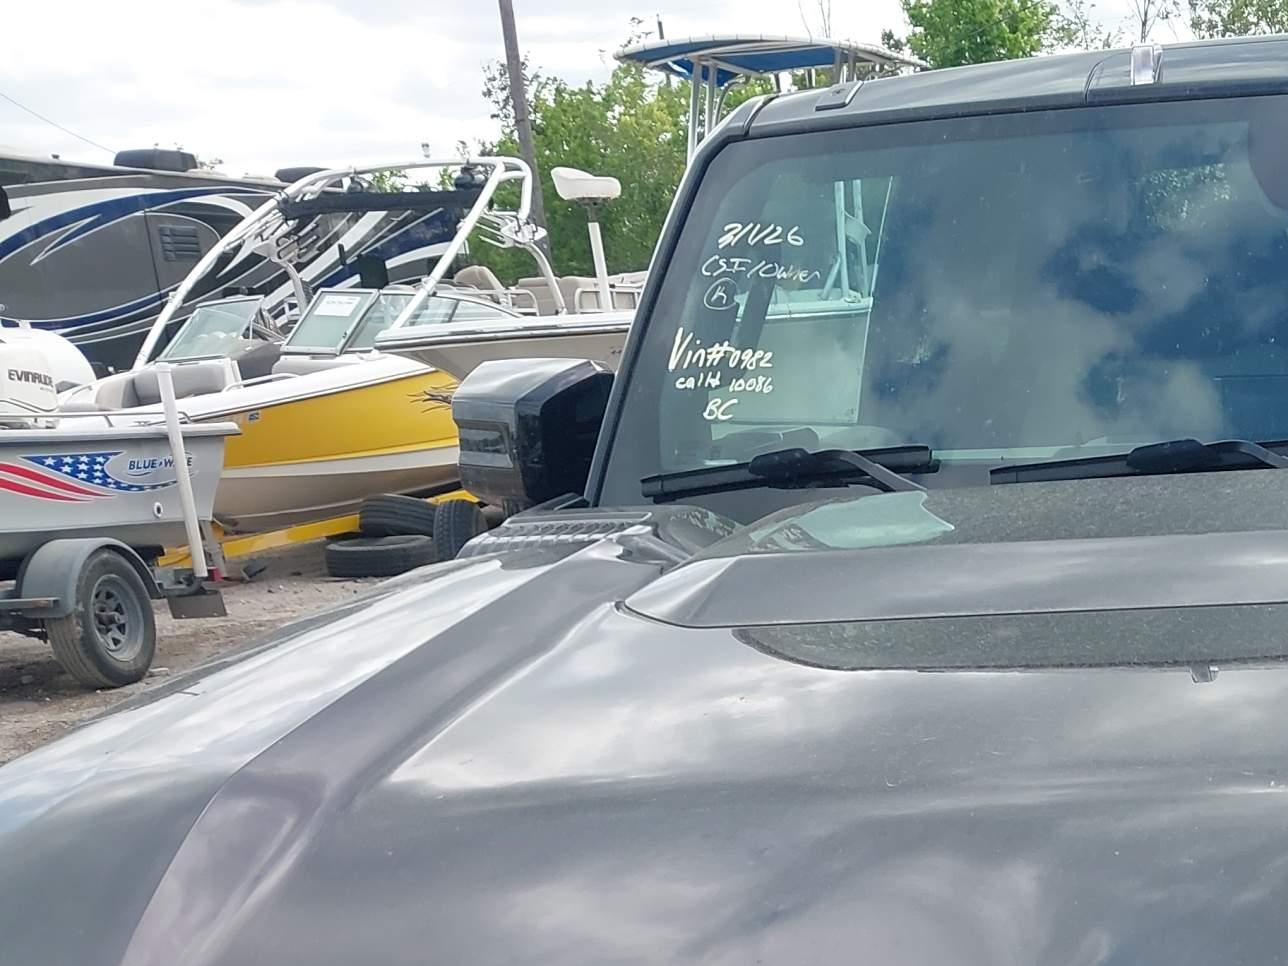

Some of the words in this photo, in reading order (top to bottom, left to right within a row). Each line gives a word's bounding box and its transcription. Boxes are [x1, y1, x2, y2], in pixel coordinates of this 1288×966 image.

[8, 369, 54, 388] EVINRUDE
[729, 376, 773, 394] 10086
[703, 398, 739, 420] BC
[128, 459, 157, 471] BLUE
